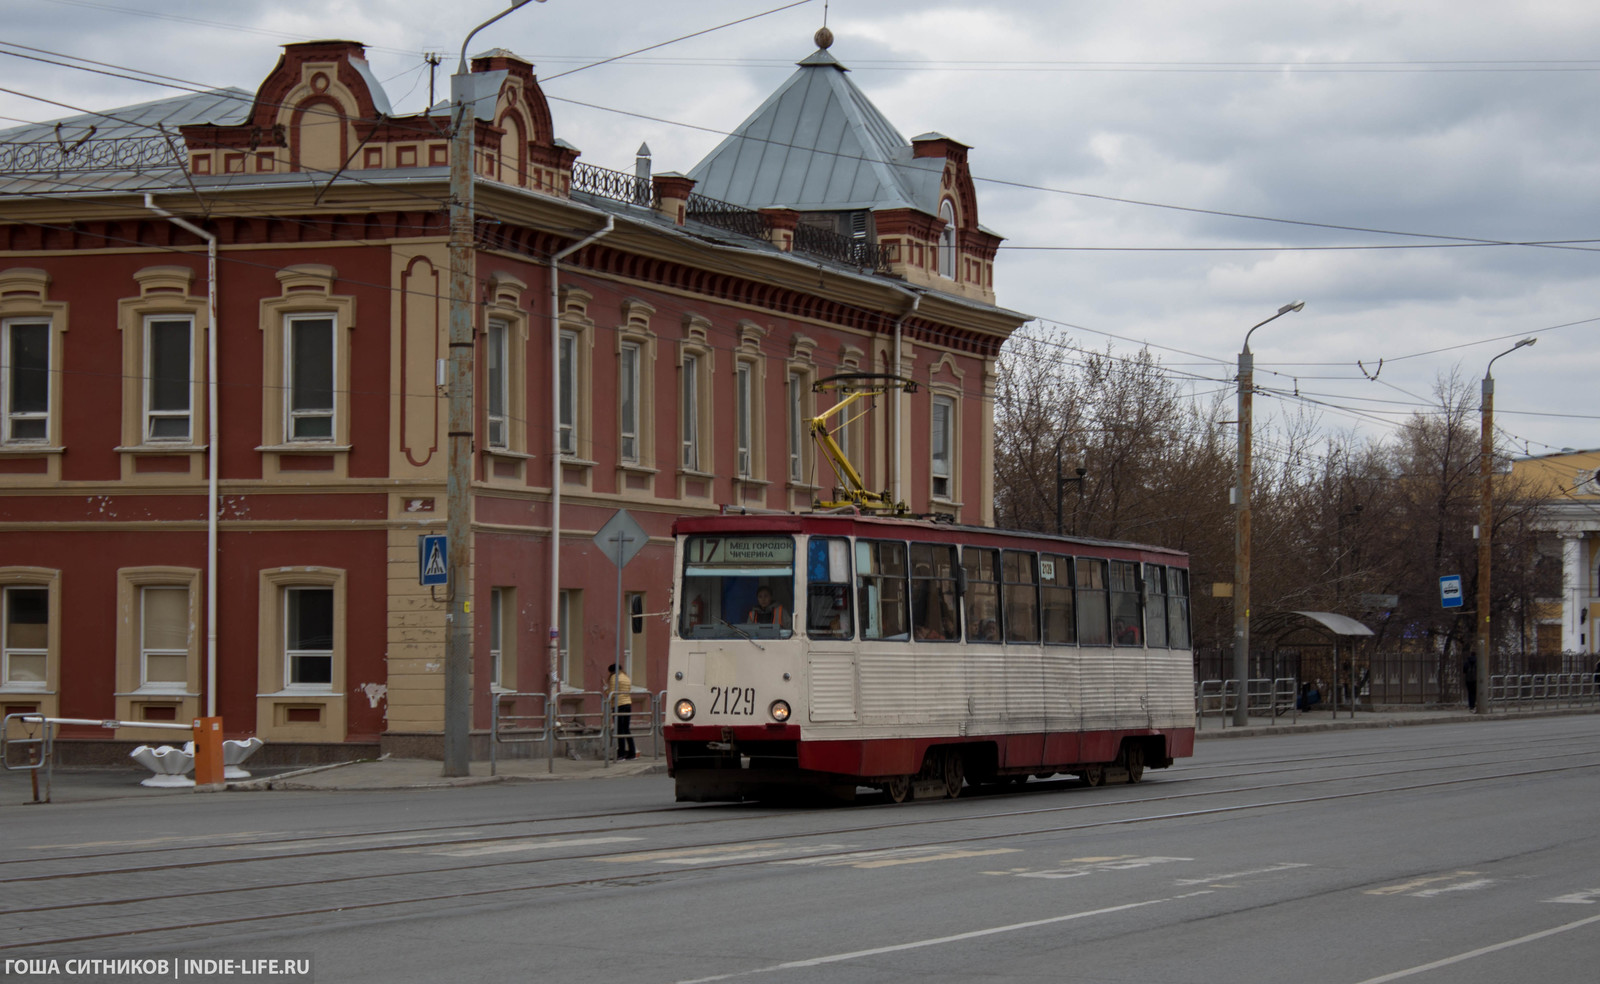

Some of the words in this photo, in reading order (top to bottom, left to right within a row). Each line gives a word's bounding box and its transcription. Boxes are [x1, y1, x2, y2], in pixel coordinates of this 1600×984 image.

[699, 539, 720, 562] 17
[730, 542, 750, 550] МЕД
[752, 542, 793, 550] ГОРОДОК
[710, 686, 755, 715] 2129
